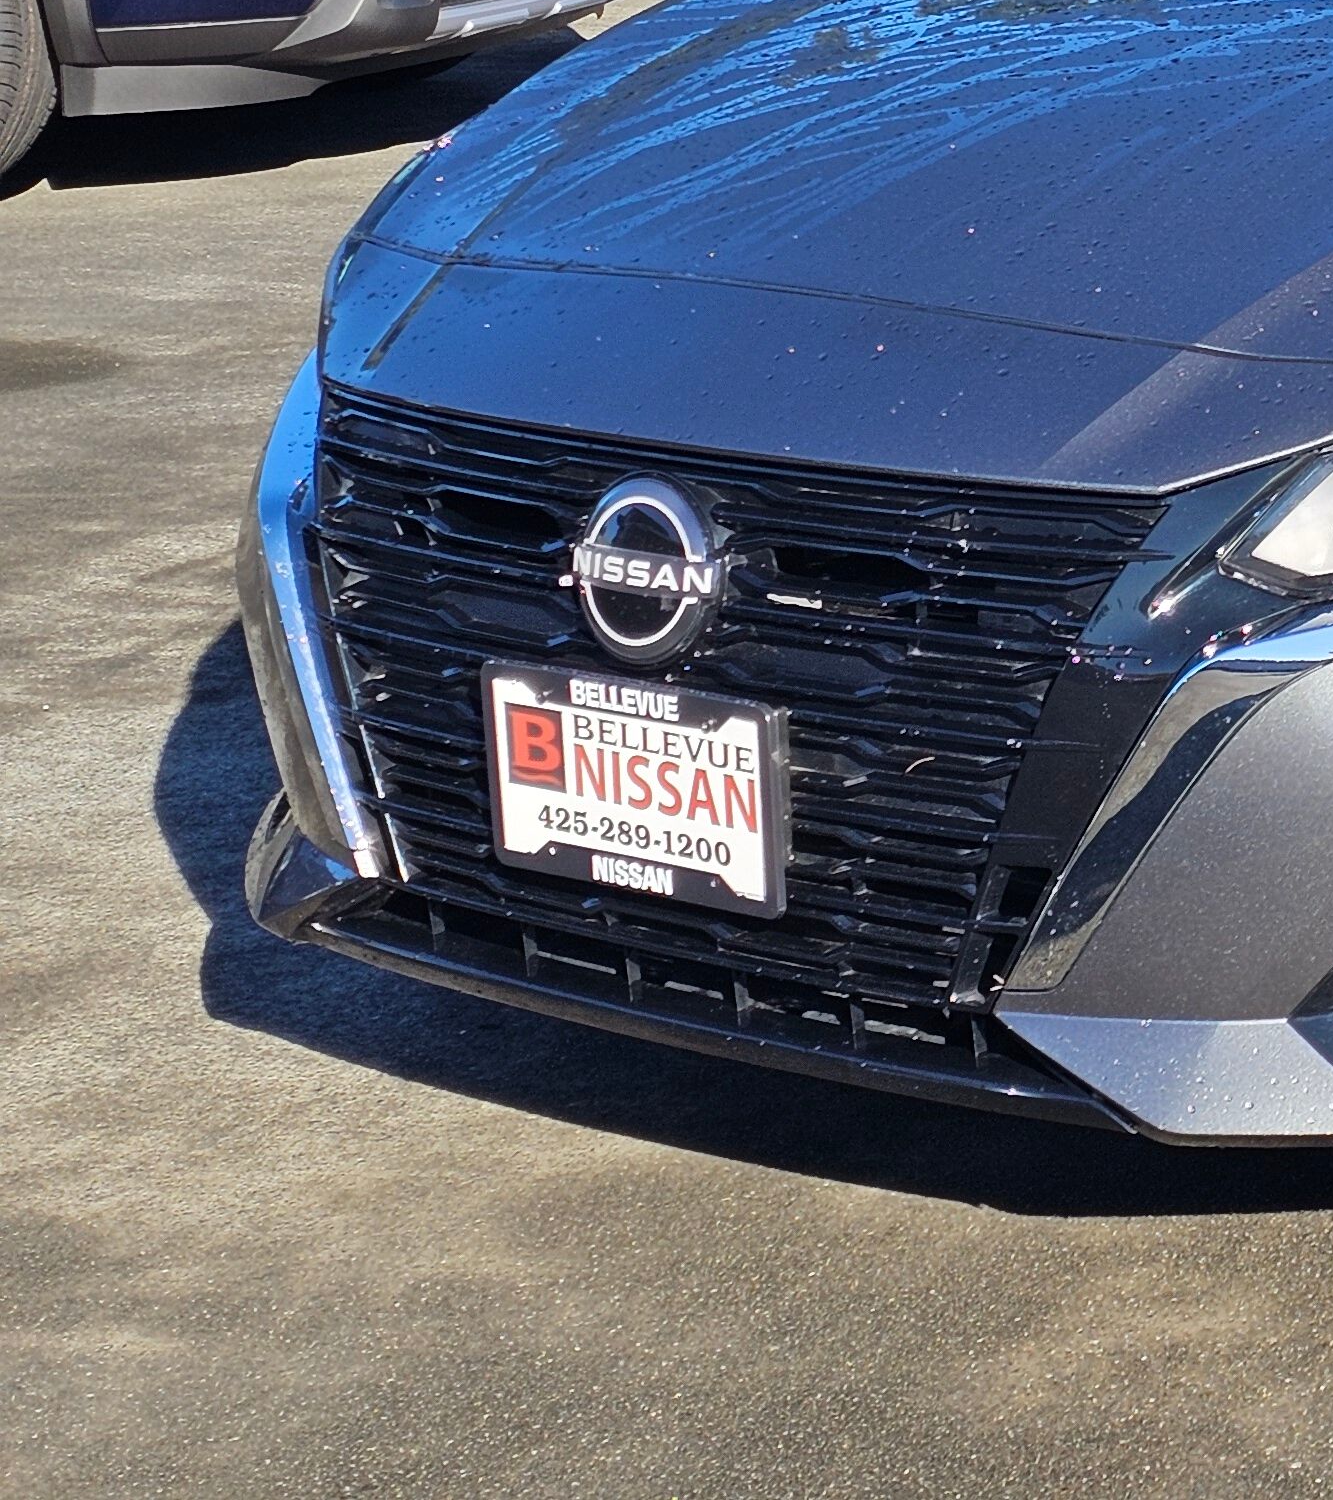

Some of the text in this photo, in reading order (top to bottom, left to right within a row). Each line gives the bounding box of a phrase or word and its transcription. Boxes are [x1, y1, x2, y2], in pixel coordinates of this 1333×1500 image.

[573, 546, 713, 594] NISSAN
[570, 679, 680, 722] BELLEVUE
[511, 711, 562, 772] B
[573, 714, 755, 773] BELLEVUE
[574, 744, 758, 834] NISSAN
[537, 804, 732, 867] 425-289-1200
[592, 854, 675, 896] NISSAN
